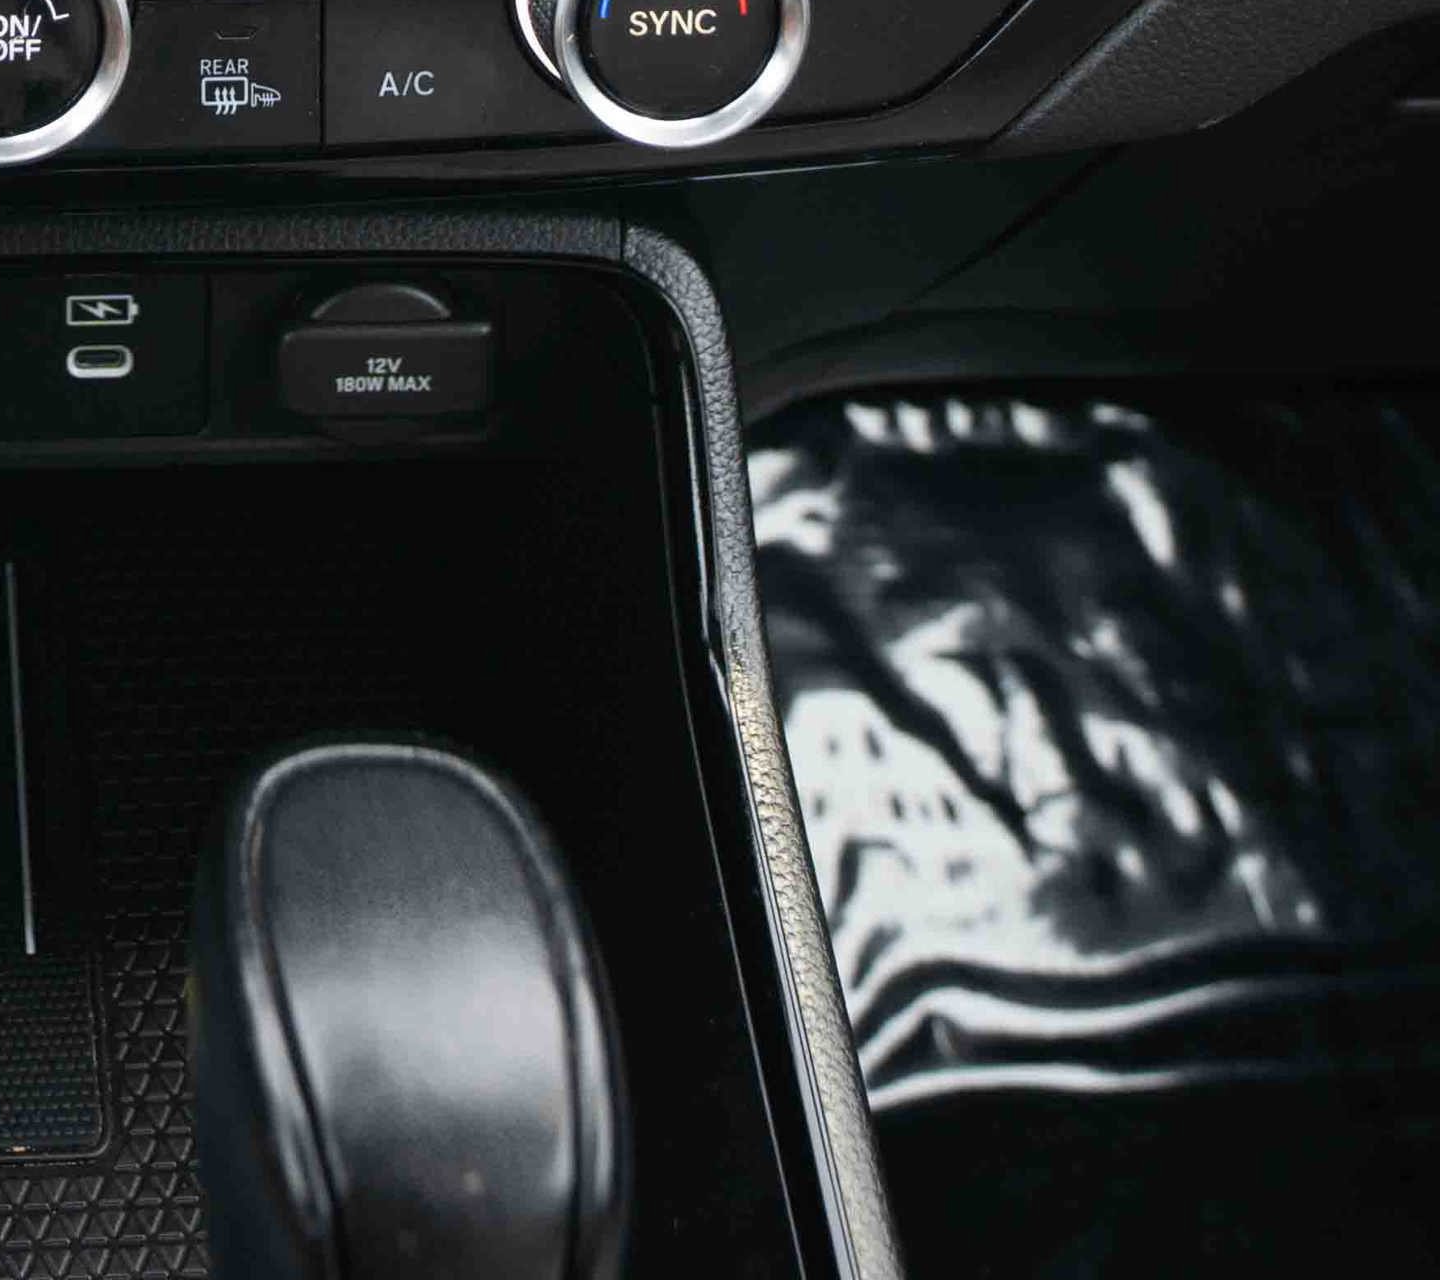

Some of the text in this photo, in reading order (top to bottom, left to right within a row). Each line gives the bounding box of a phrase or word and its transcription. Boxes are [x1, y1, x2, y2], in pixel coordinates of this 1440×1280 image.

[629, 9, 718, 37] SYNC
[200, 58, 250, 76] REAR
[378, 70, 435, 98] A/C
[366, 357, 403, 374] 12V
[335, 375, 433, 393] 180W MAX
